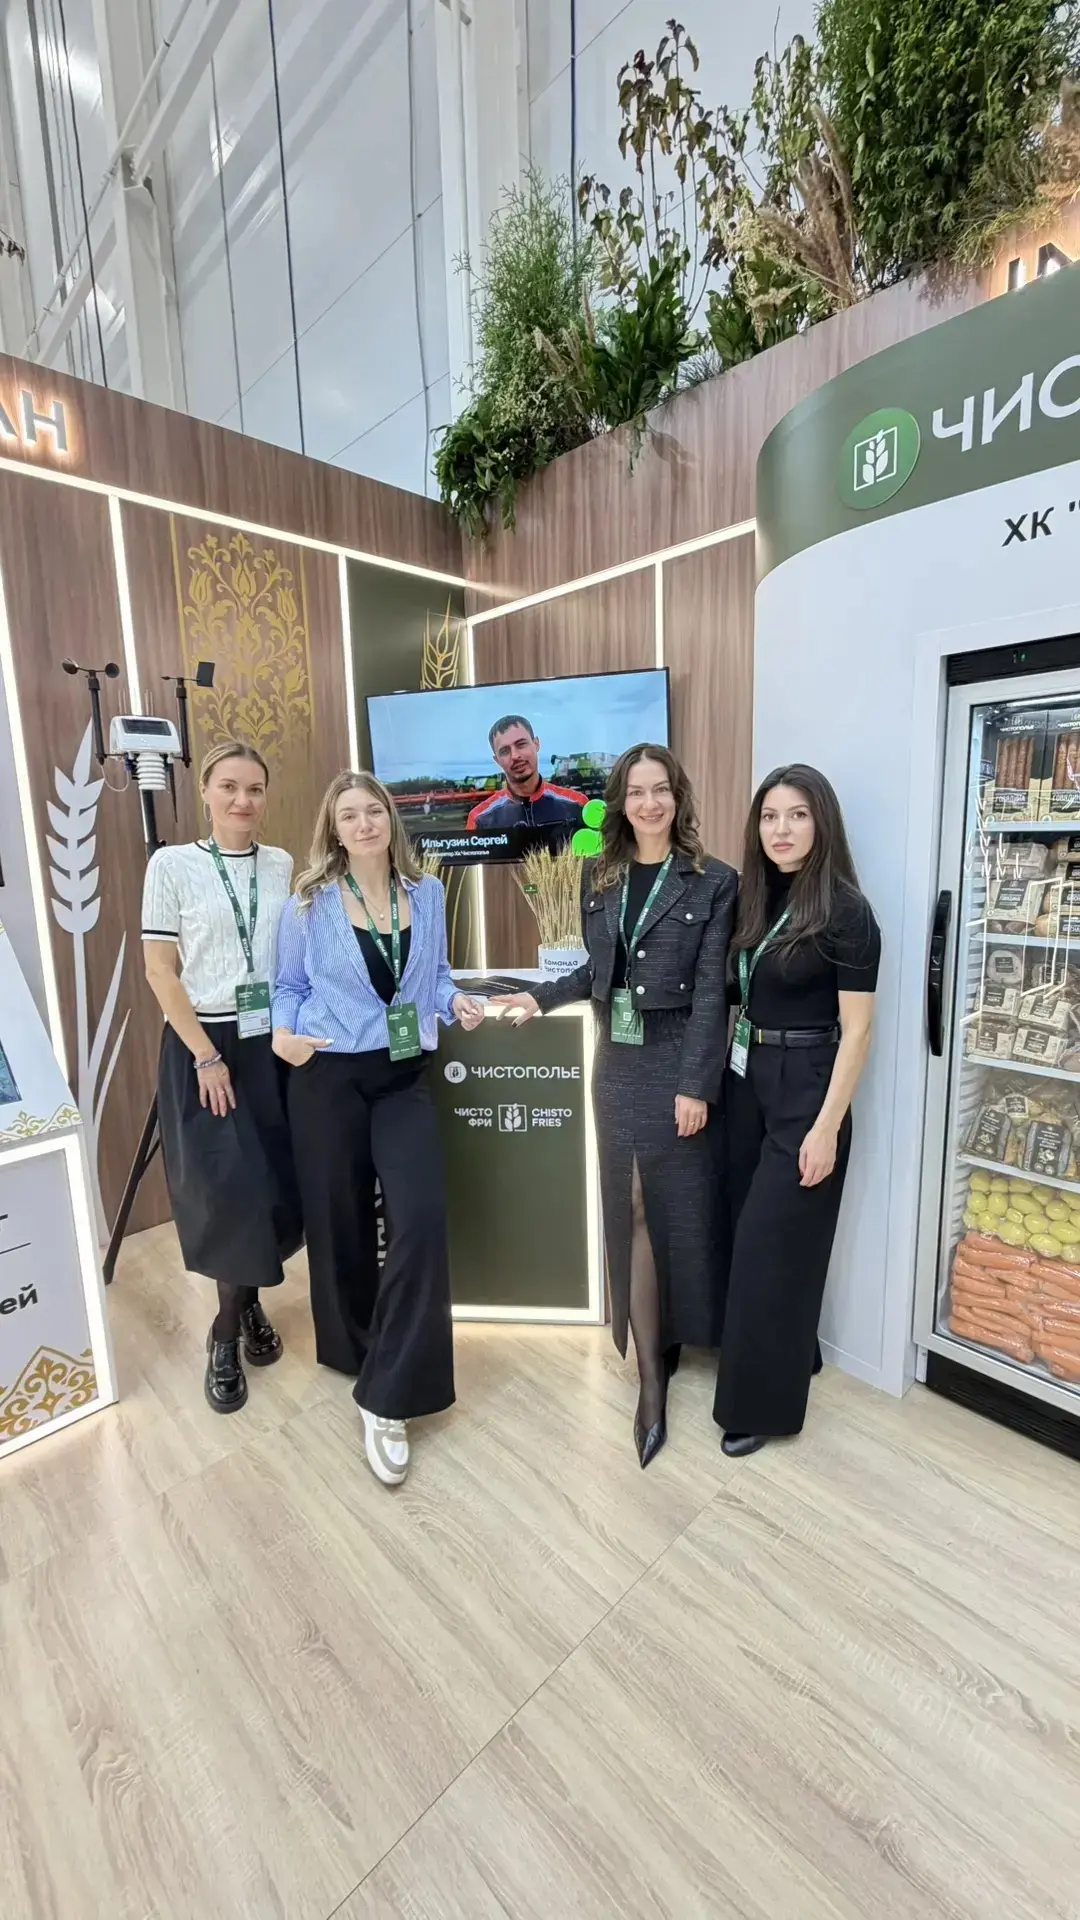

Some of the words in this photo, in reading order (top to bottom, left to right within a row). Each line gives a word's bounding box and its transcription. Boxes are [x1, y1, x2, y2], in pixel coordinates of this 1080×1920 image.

[932, 353, 1080, 452] ЧИС
[1001, 506, 1055, 548] ХК
[421, 838, 469, 850] Ильгузин
[470, 834, 508, 847] Сергей
[471, 1066, 581, 1079] ЧИСТОПОЛЬЕ
[454, 1107, 493, 1117] ЧИСТО
[531, 1108, 573, 1118] CHISTO
[468, 1117, 493, 1127] ФРИ
[531, 1118, 562, 1127] FRIES
